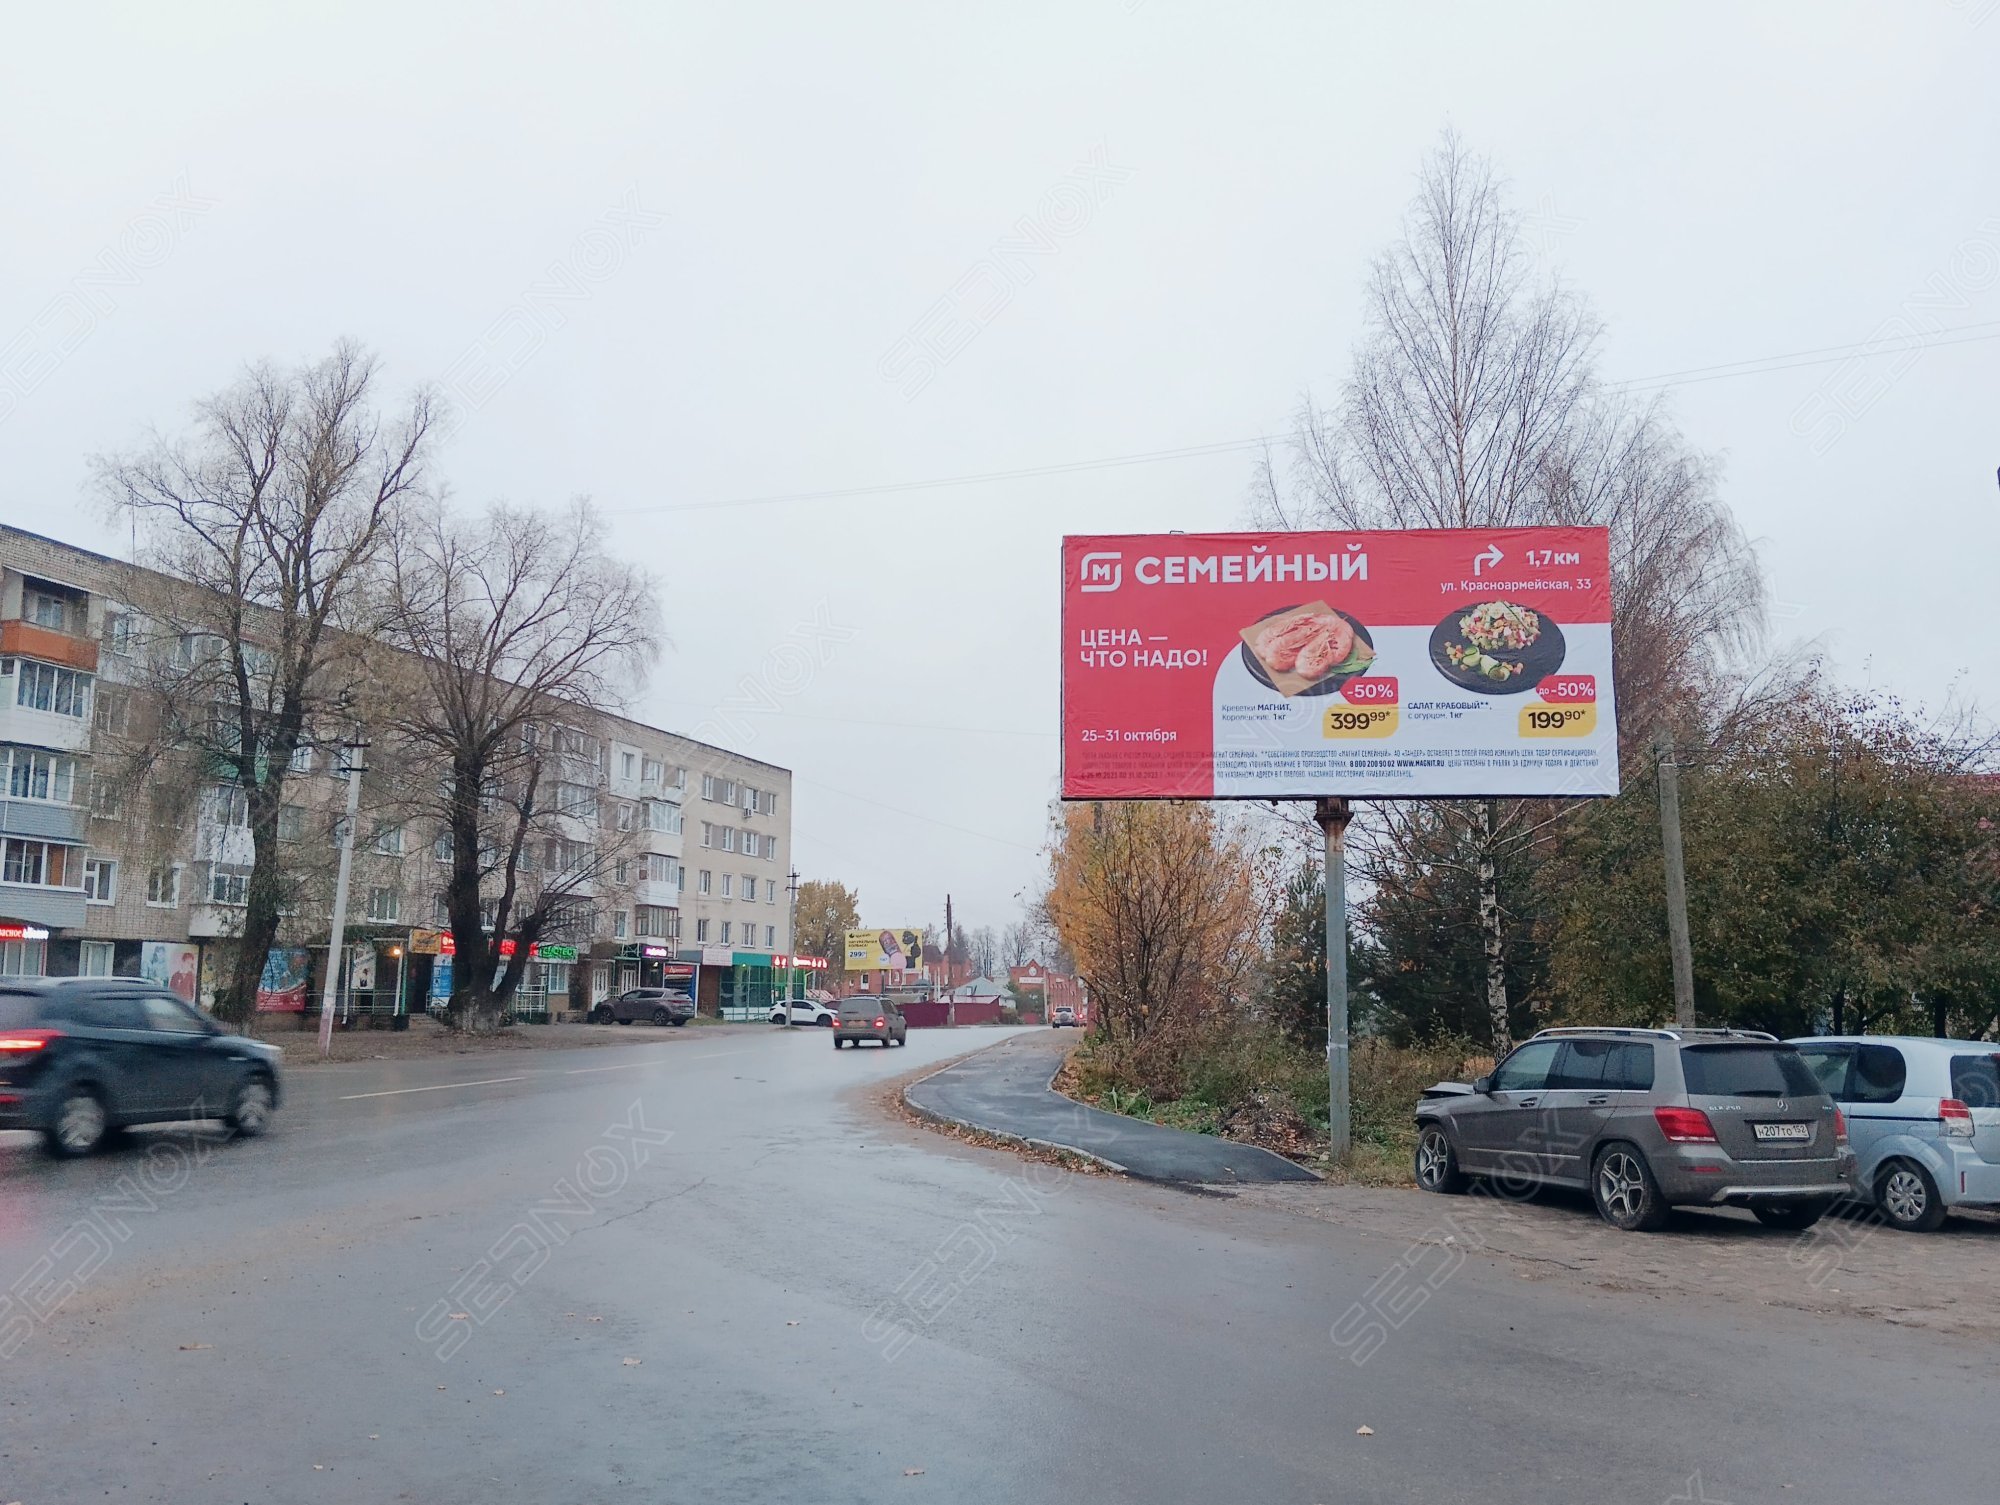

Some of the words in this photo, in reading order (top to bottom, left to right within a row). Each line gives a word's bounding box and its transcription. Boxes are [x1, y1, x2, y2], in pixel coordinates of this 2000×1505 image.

[1135, 543, 1368, 585] СЕМЕЙНЫЙ
[1440, 582, 1457, 594] ул.
[1461, 579, 1573, 593] Красноармейская,
[1576, 578, 1592, 590] 33
[1081, 629, 1142, 648] ЦЕНА
[1081, 651, 1127, 667] ЧТО
[1133, 649, 1207, 669] НАДО!
[1347, 684, 1394, 698] -50%
[1538, 687, 1550, 696] до
[1551, 682, 1595, 697] -50%
[1222, 704, 1256, 713] Креветки
[1257, 703, 1292, 712] МАГНИТ,
[1408, 702, 1433, 710] САЛАТ
[1124, 729, 1177, 744] октября
